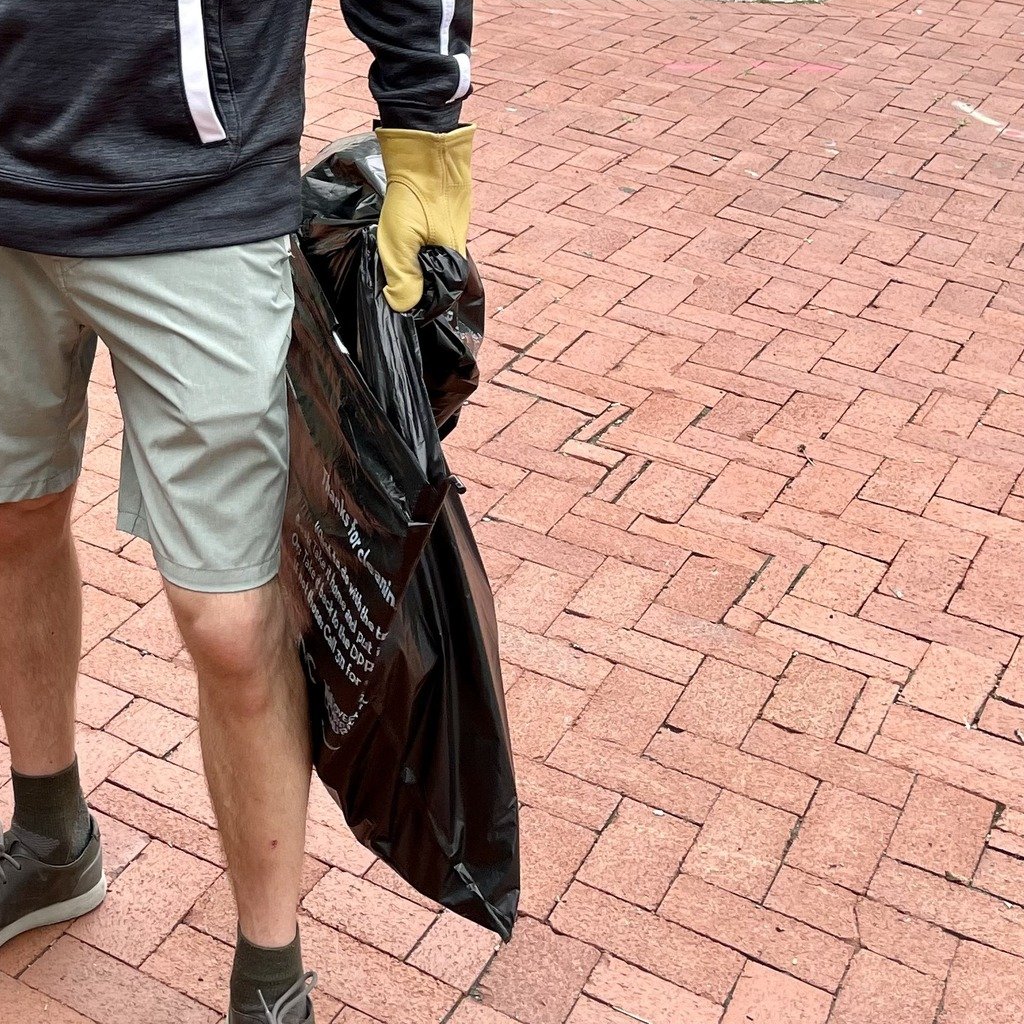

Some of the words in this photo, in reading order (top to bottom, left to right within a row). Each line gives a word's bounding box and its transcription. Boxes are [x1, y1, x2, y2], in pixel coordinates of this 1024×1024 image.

[347, 518, 362, 550] for
[349, 582, 362, 612] with
[360, 606, 374, 633] the
[345, 663, 362, 686] for
